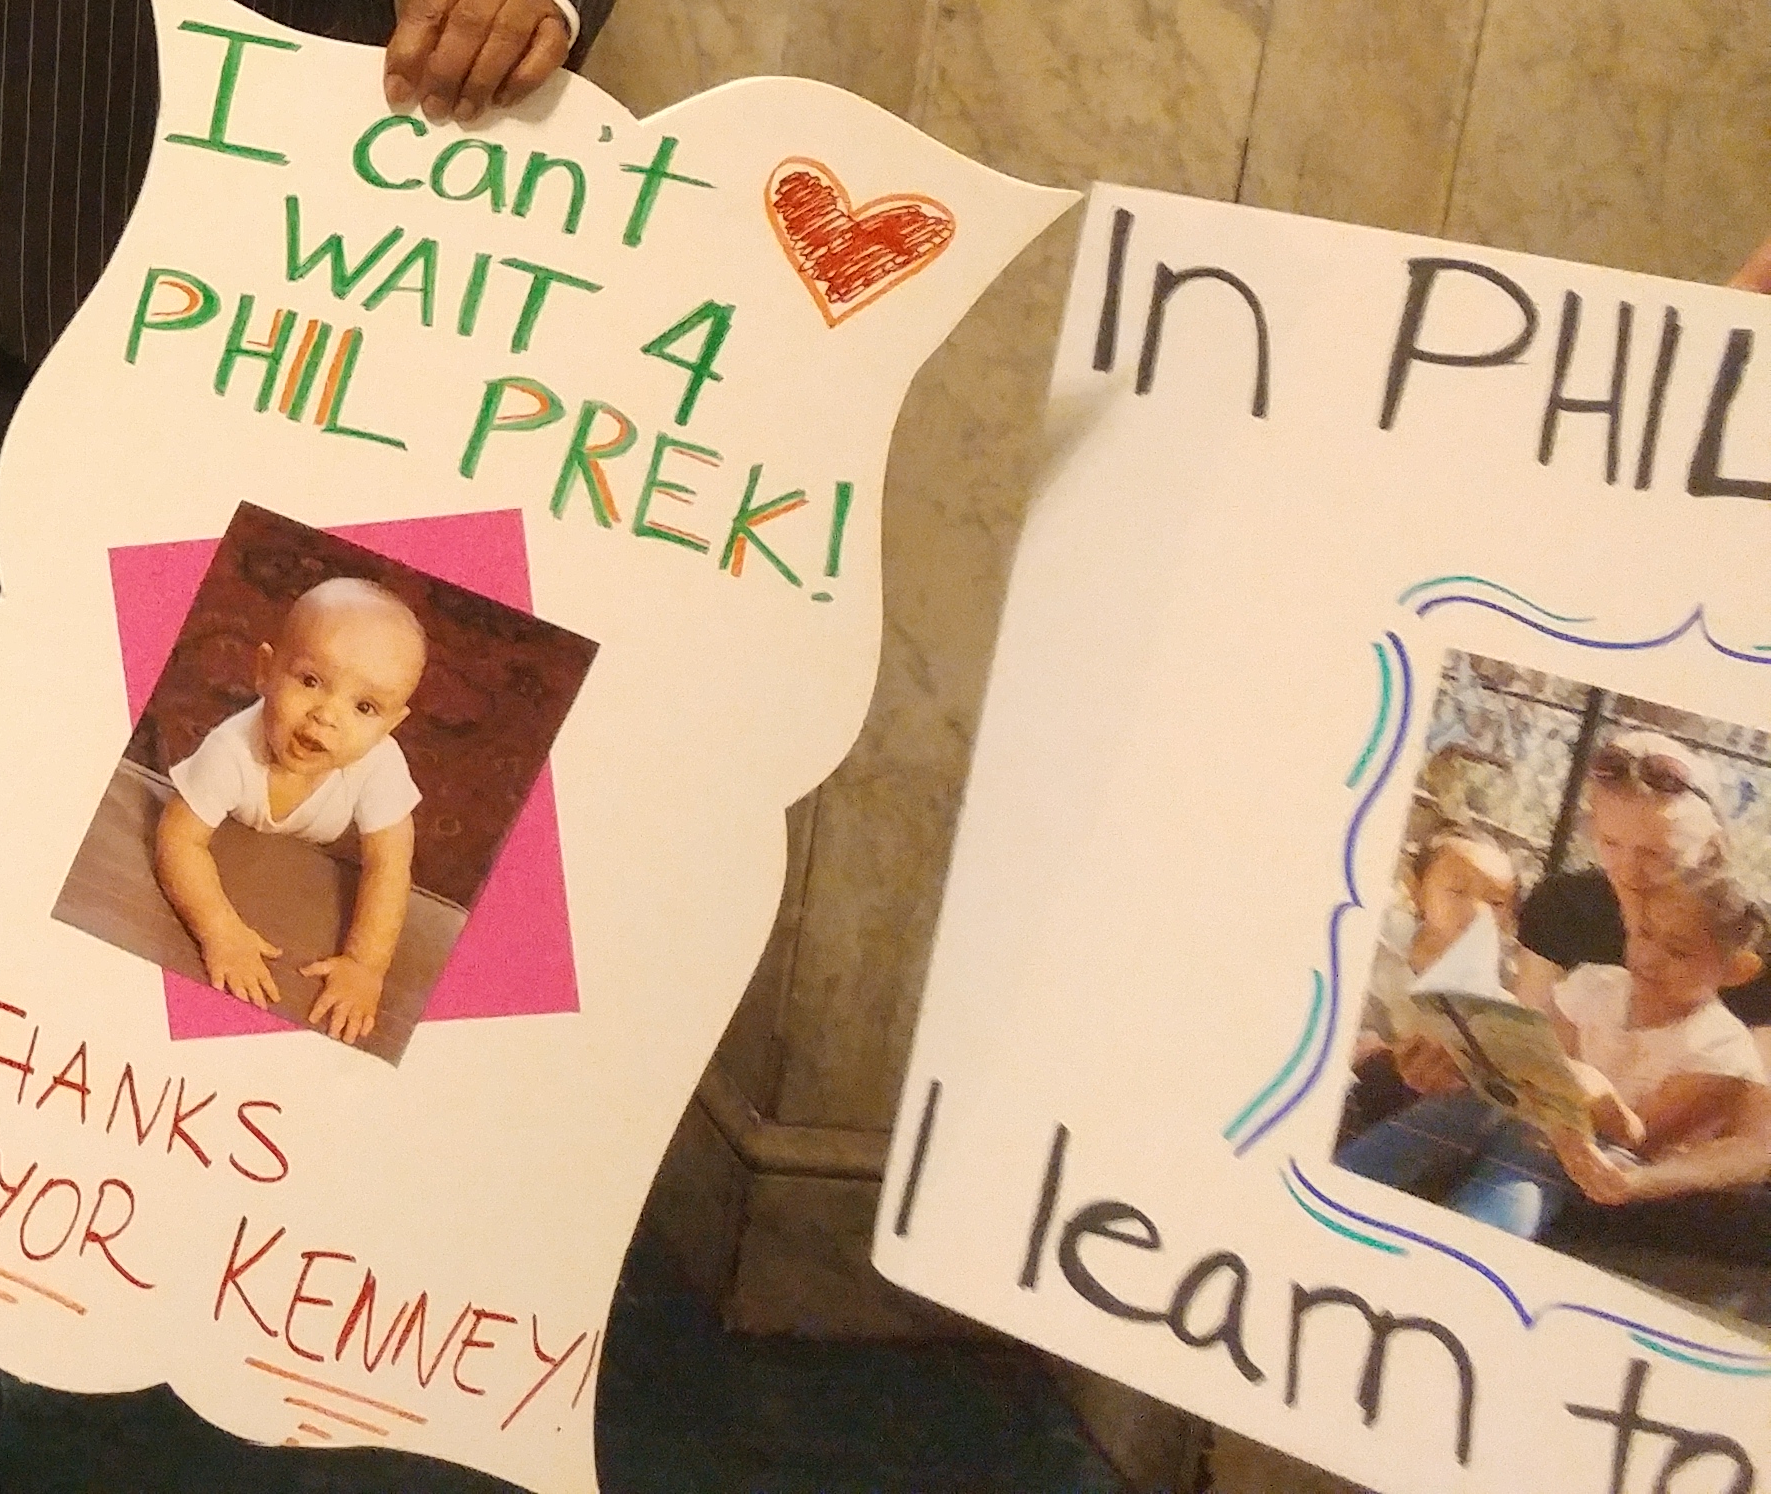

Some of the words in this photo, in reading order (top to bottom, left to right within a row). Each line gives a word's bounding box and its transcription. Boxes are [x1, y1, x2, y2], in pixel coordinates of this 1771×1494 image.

[163, 19, 302, 166] I
[352, 114, 717, 246] can't
[285, 195, 604, 354] WAIT
[641, 299, 735, 426] 4
[1093, 208, 1271, 418] In
[124, 267, 407, 452] PHIL
[458, 378, 854, 603] PREK!
[214, 1217, 600, 1432] KENNEY!
[895, 1080, 942, 1237] I
[1019, 1120, 1473, 1465] learn
